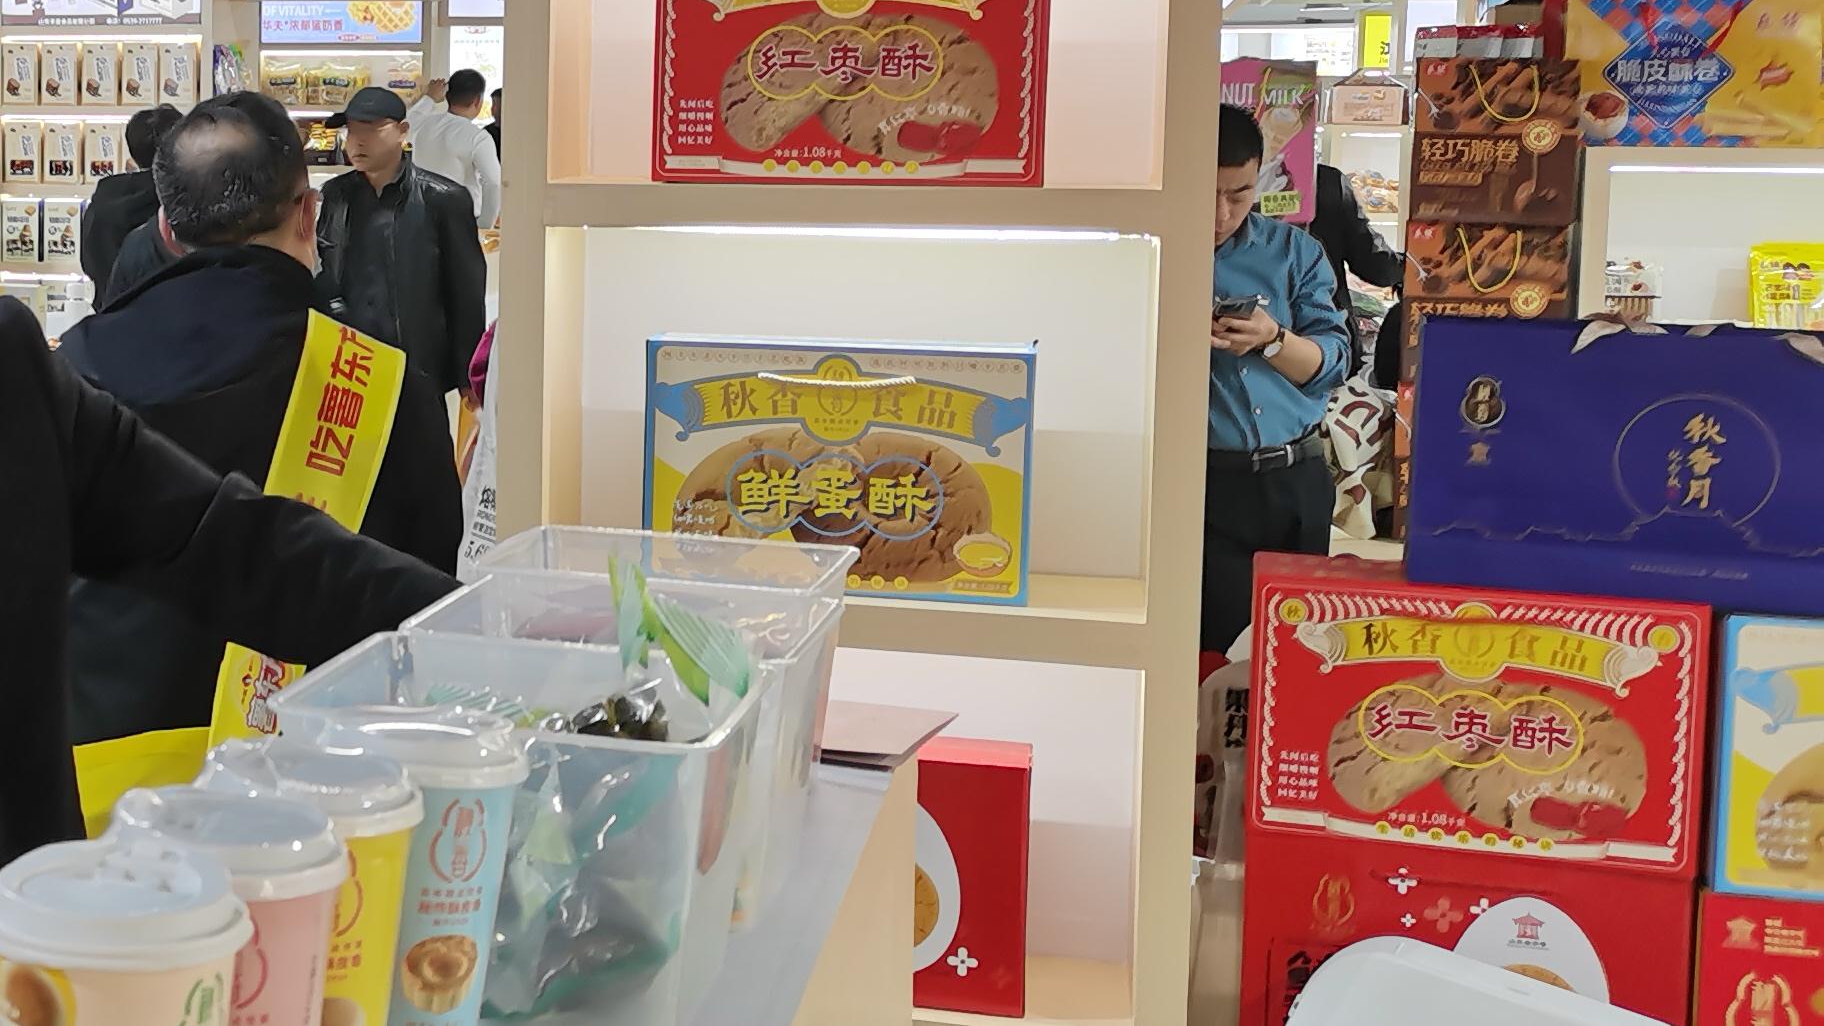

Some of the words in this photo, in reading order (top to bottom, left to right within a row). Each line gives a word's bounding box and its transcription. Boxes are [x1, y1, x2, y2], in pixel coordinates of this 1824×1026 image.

[278, 5, 325, 16] VITALITY
[755, 42, 937, 83] 红枣酥
[1263, 89, 1304, 106] MILK
[1421, 138, 1519, 163] 轻巧脆卷
[720, 381, 804, 417] 秋香
[1682, 413, 1727, 509] 秋香月
[736, 468, 932, 521] 鲜蛋酥
[1361, 622, 1442, 656] 秋香
[1504, 628, 1589, 673] 食品
[1368, 704, 1574, 758] 红枣酥
